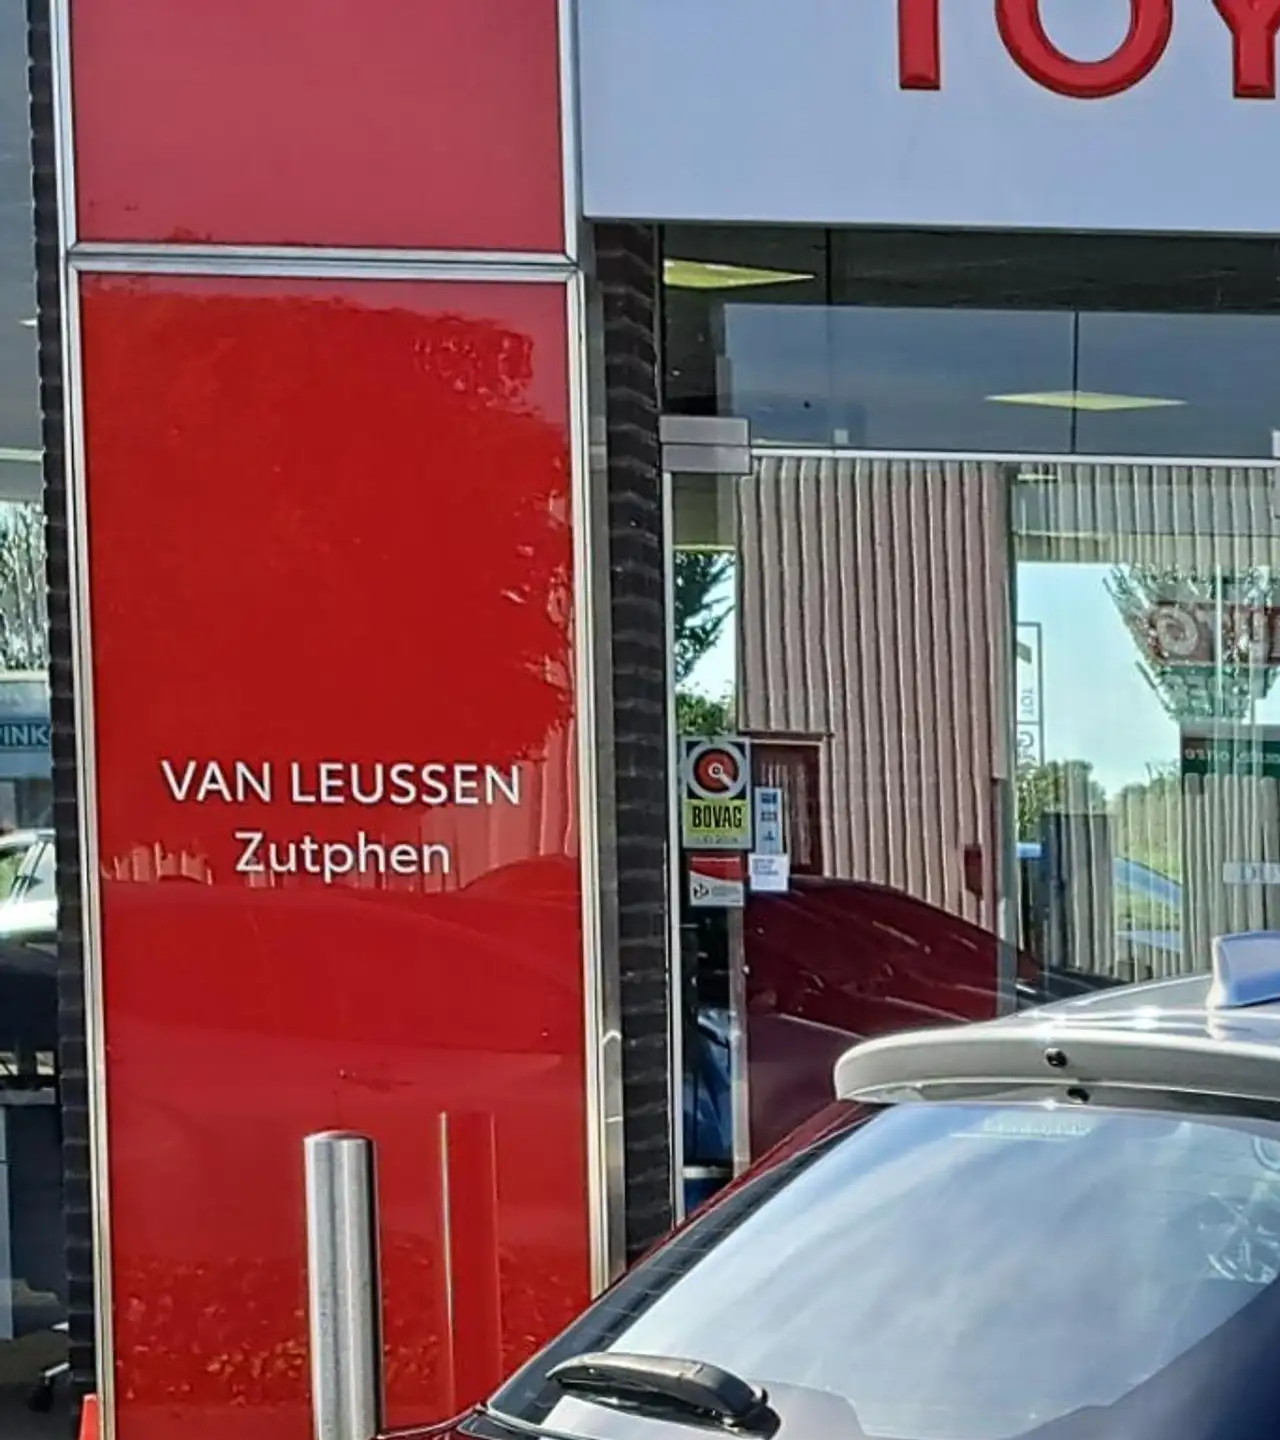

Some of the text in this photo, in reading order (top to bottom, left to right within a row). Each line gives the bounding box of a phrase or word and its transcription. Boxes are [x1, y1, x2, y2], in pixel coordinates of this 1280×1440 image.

[0, 725, 49, 746] INK
[161, 759, 522, 807] VAN LEUSSEN
[691, 805, 743, 829] BOVAG
[233, 831, 452, 884] Zutphen
